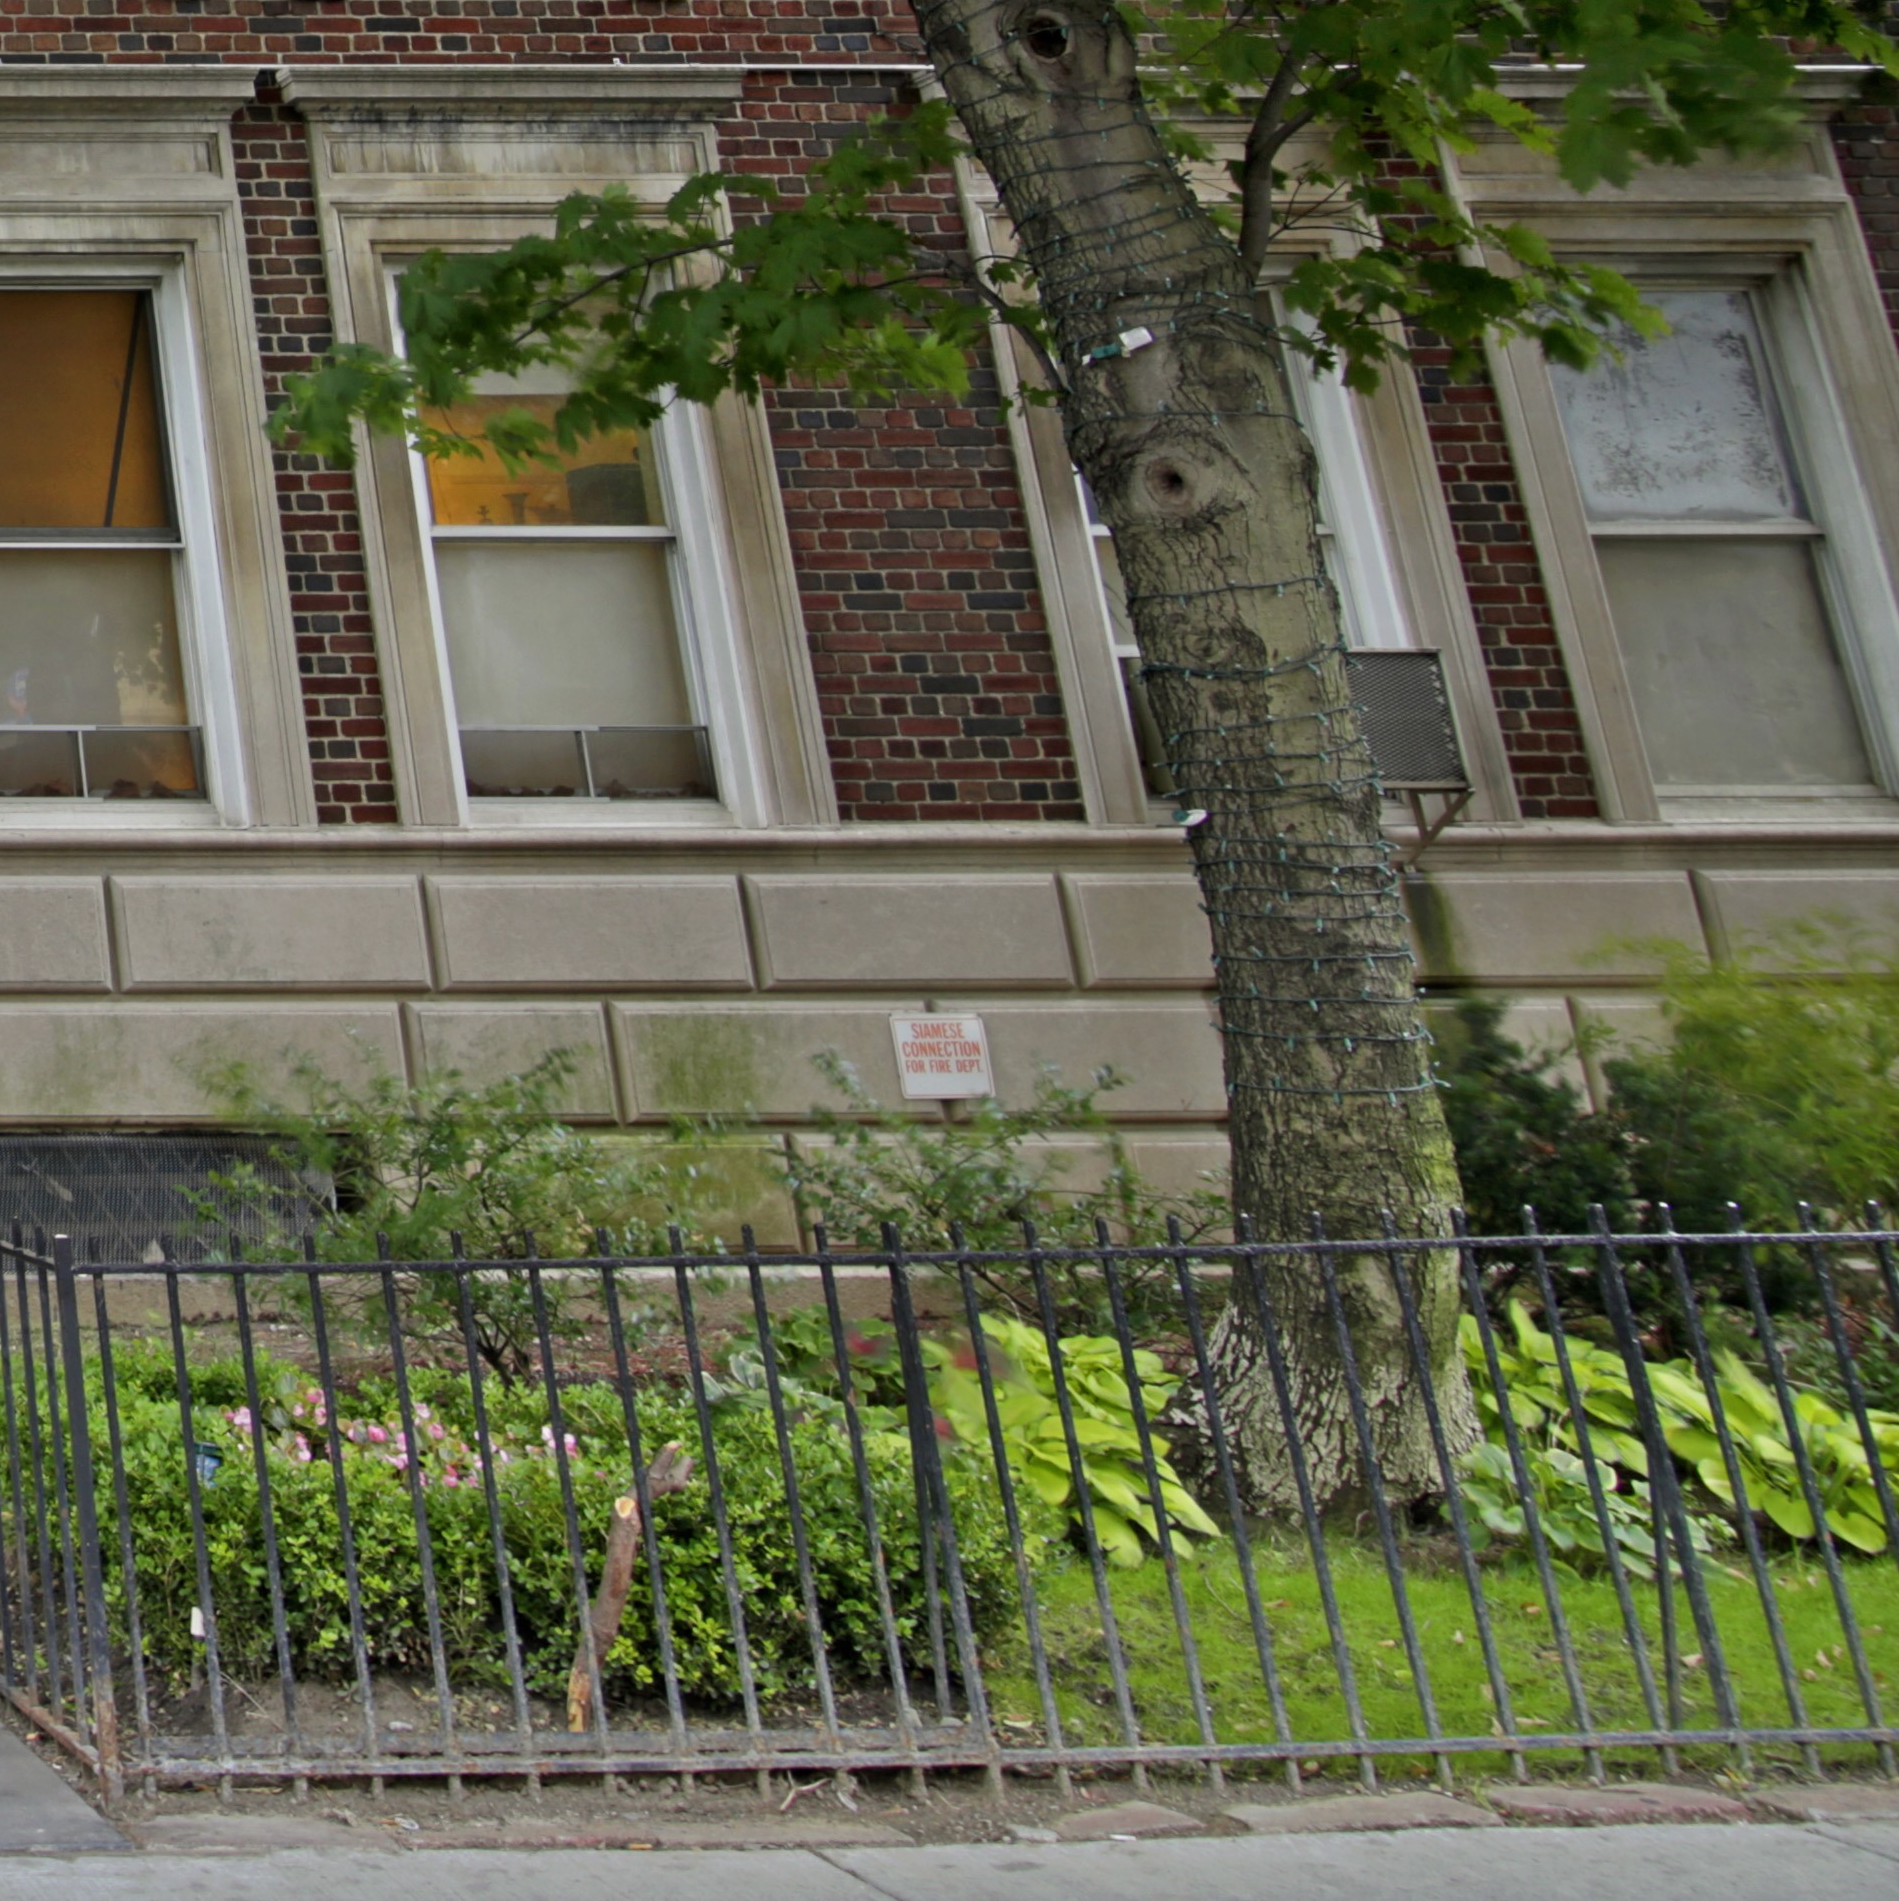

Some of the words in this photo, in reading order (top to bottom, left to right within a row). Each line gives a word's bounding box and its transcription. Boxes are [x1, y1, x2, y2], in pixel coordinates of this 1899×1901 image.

[910, 1022, 966, 1039] SIAMESE
[902, 1041, 982, 1058] CONNECTION
[905, 1059, 926, 1074] FOR
[929, 1059, 952, 1074] FIRE
[955, 1059, 985, 1074] DEPT.
